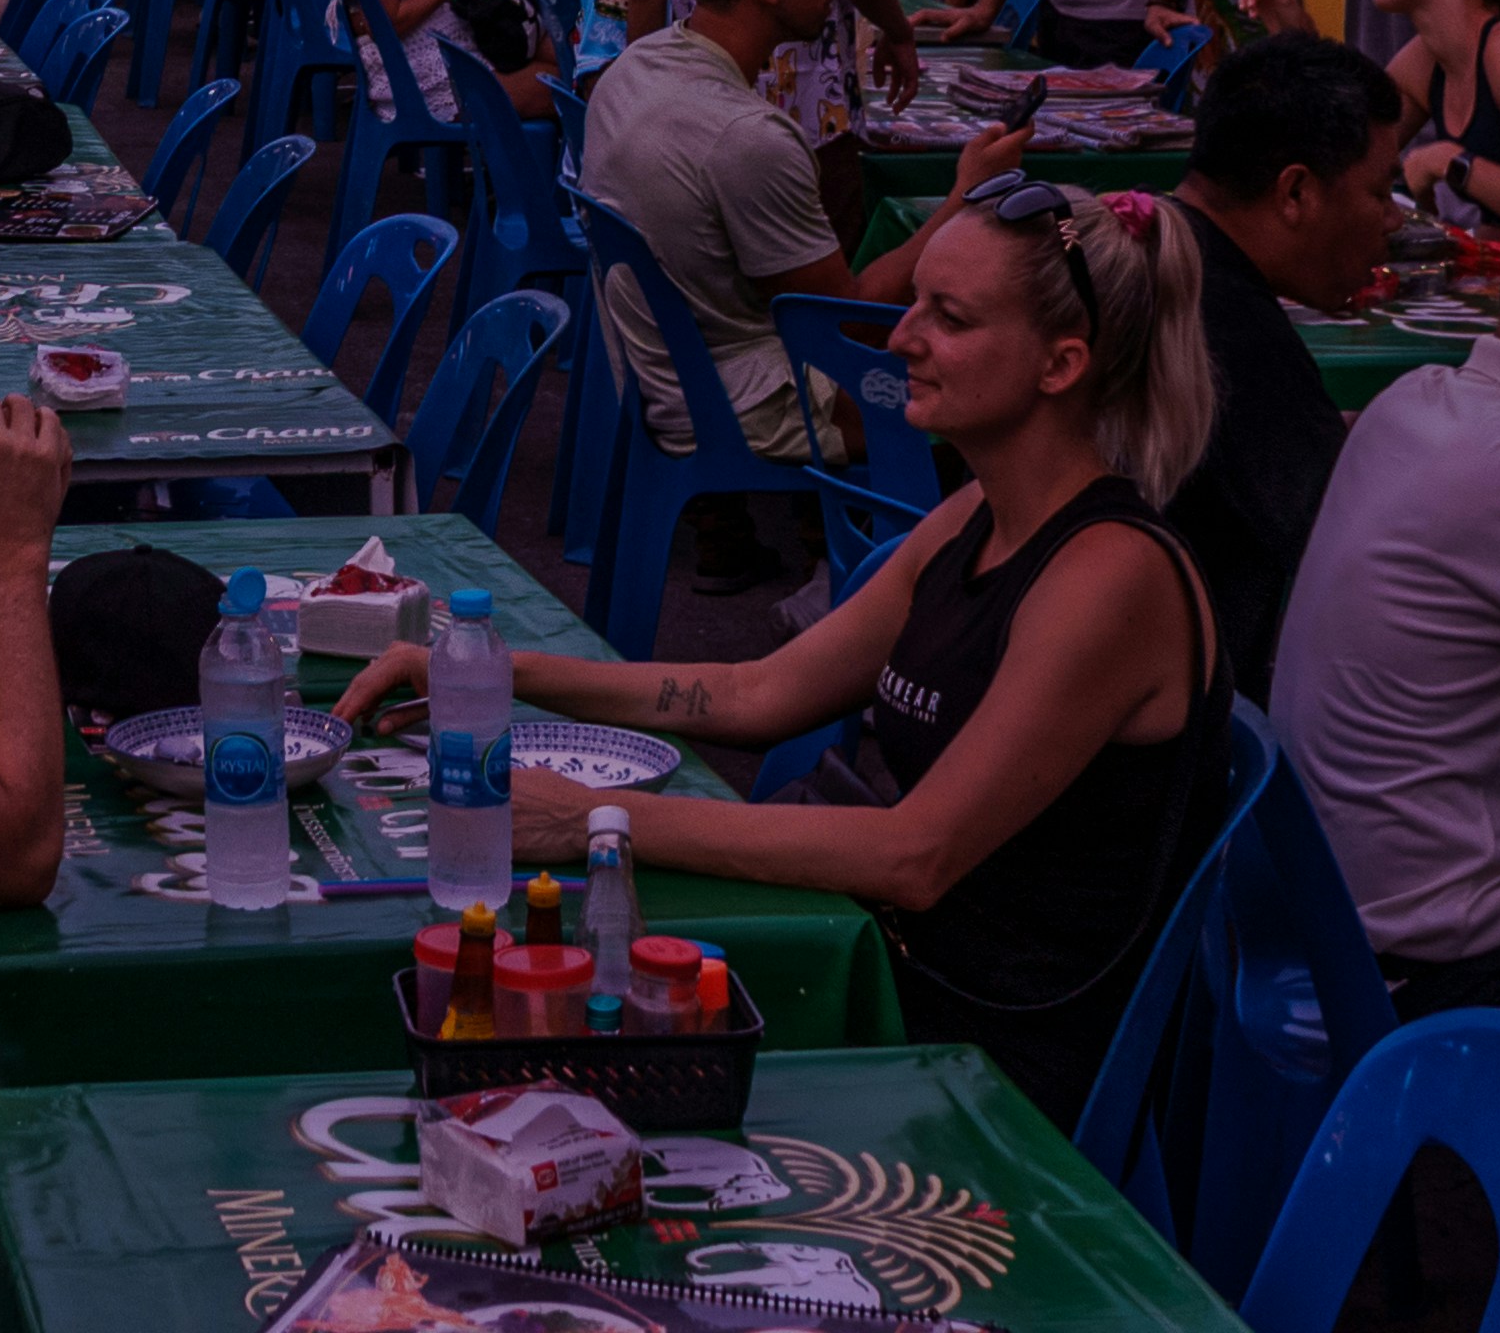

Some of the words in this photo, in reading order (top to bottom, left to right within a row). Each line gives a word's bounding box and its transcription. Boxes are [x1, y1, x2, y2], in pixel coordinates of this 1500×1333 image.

[197, 367, 337, 381] Chan
[205, 425, 374, 441] Chang
[214, 757, 266, 775] CRYSTAL
